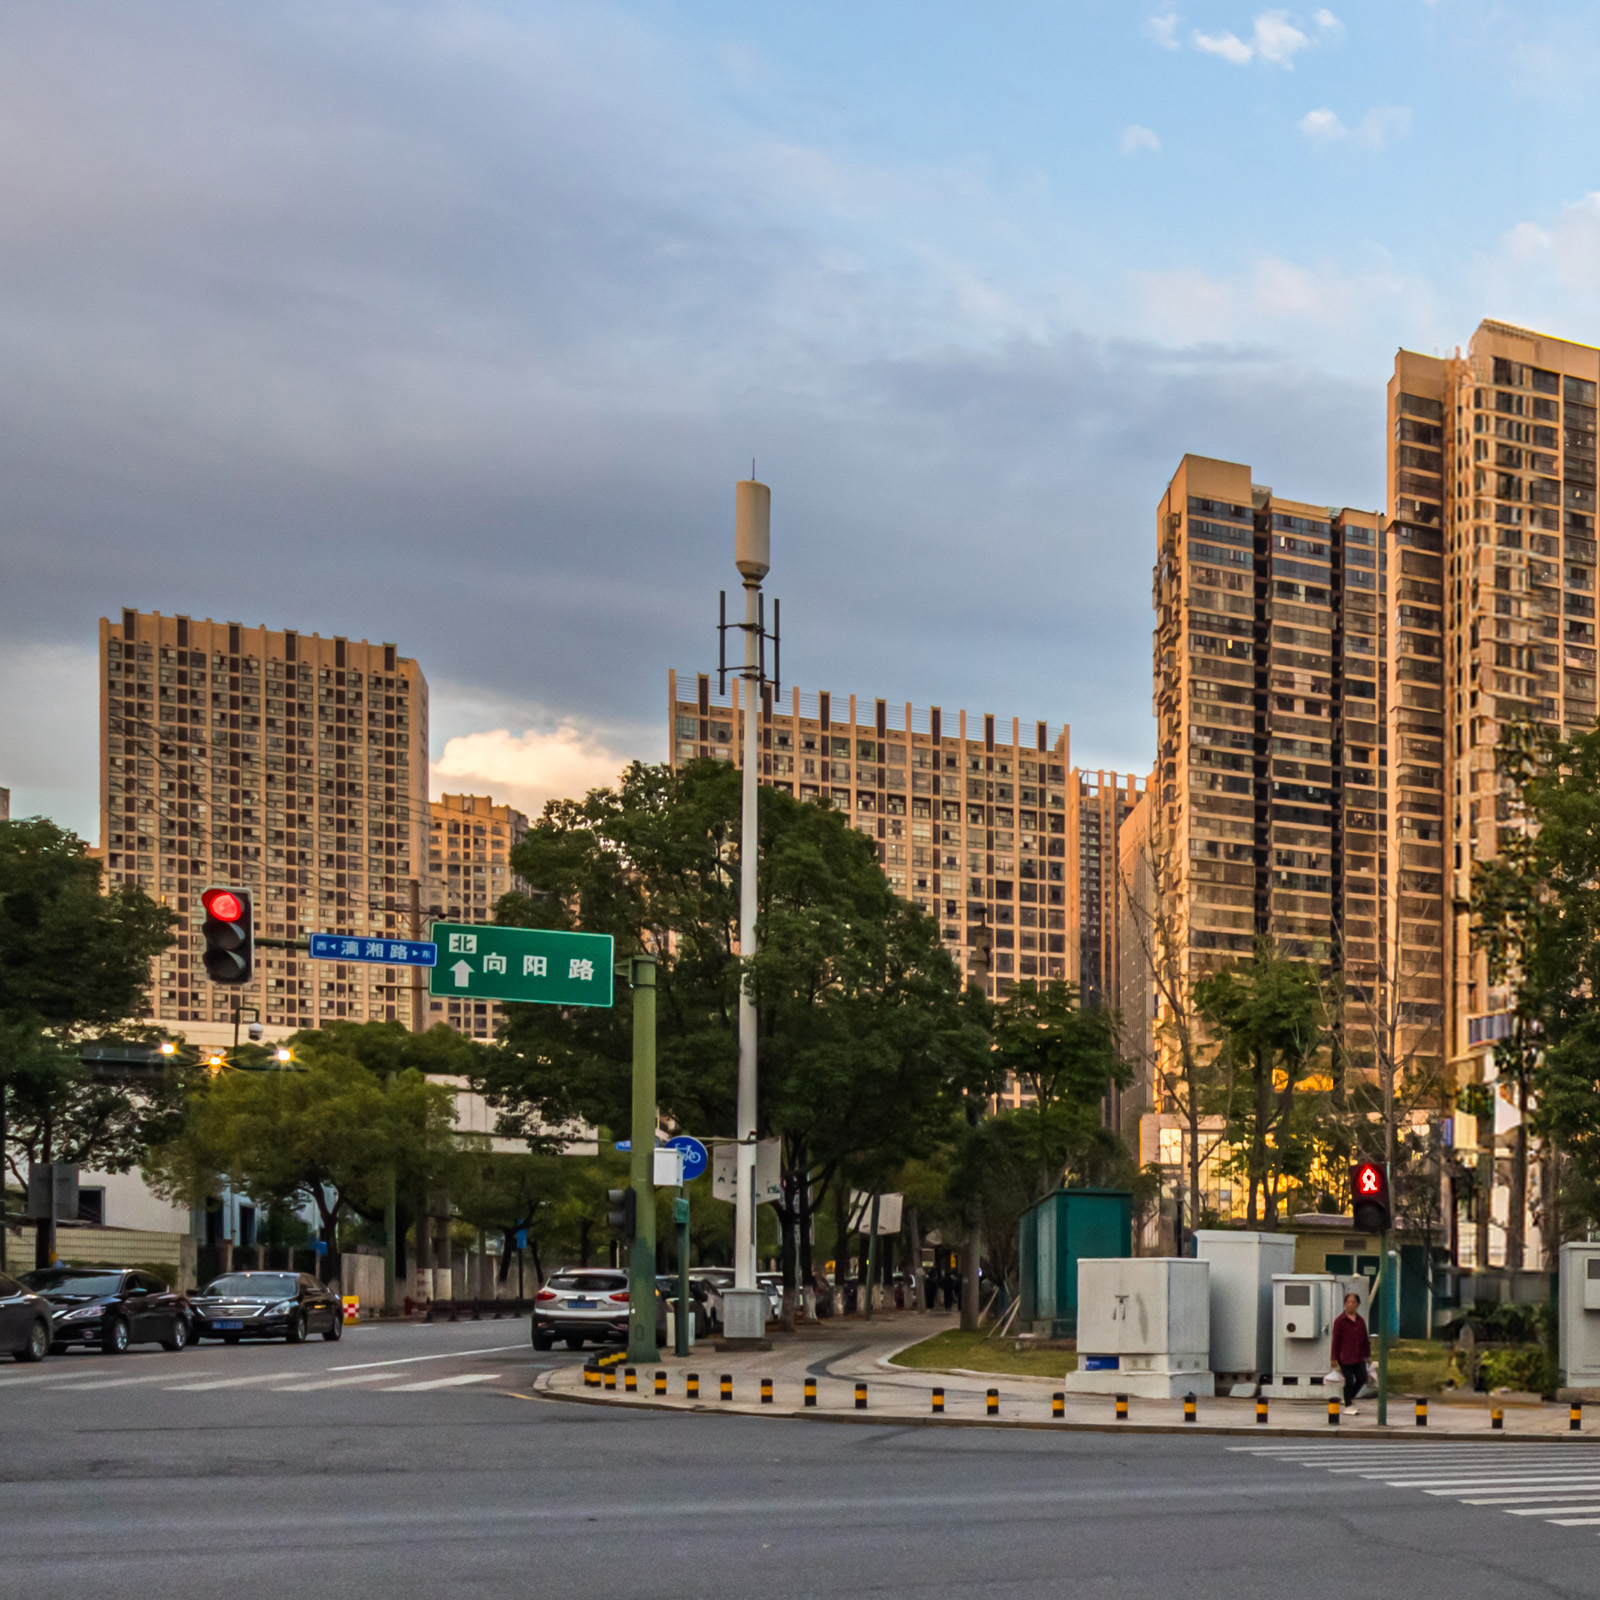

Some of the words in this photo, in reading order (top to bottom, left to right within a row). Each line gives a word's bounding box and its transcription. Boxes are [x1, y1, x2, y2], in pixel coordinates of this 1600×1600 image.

[341, 939, 408, 960] 漓湘路
[451, 934, 475, 952] 北
[482, 952, 595, 981] 向阳路
